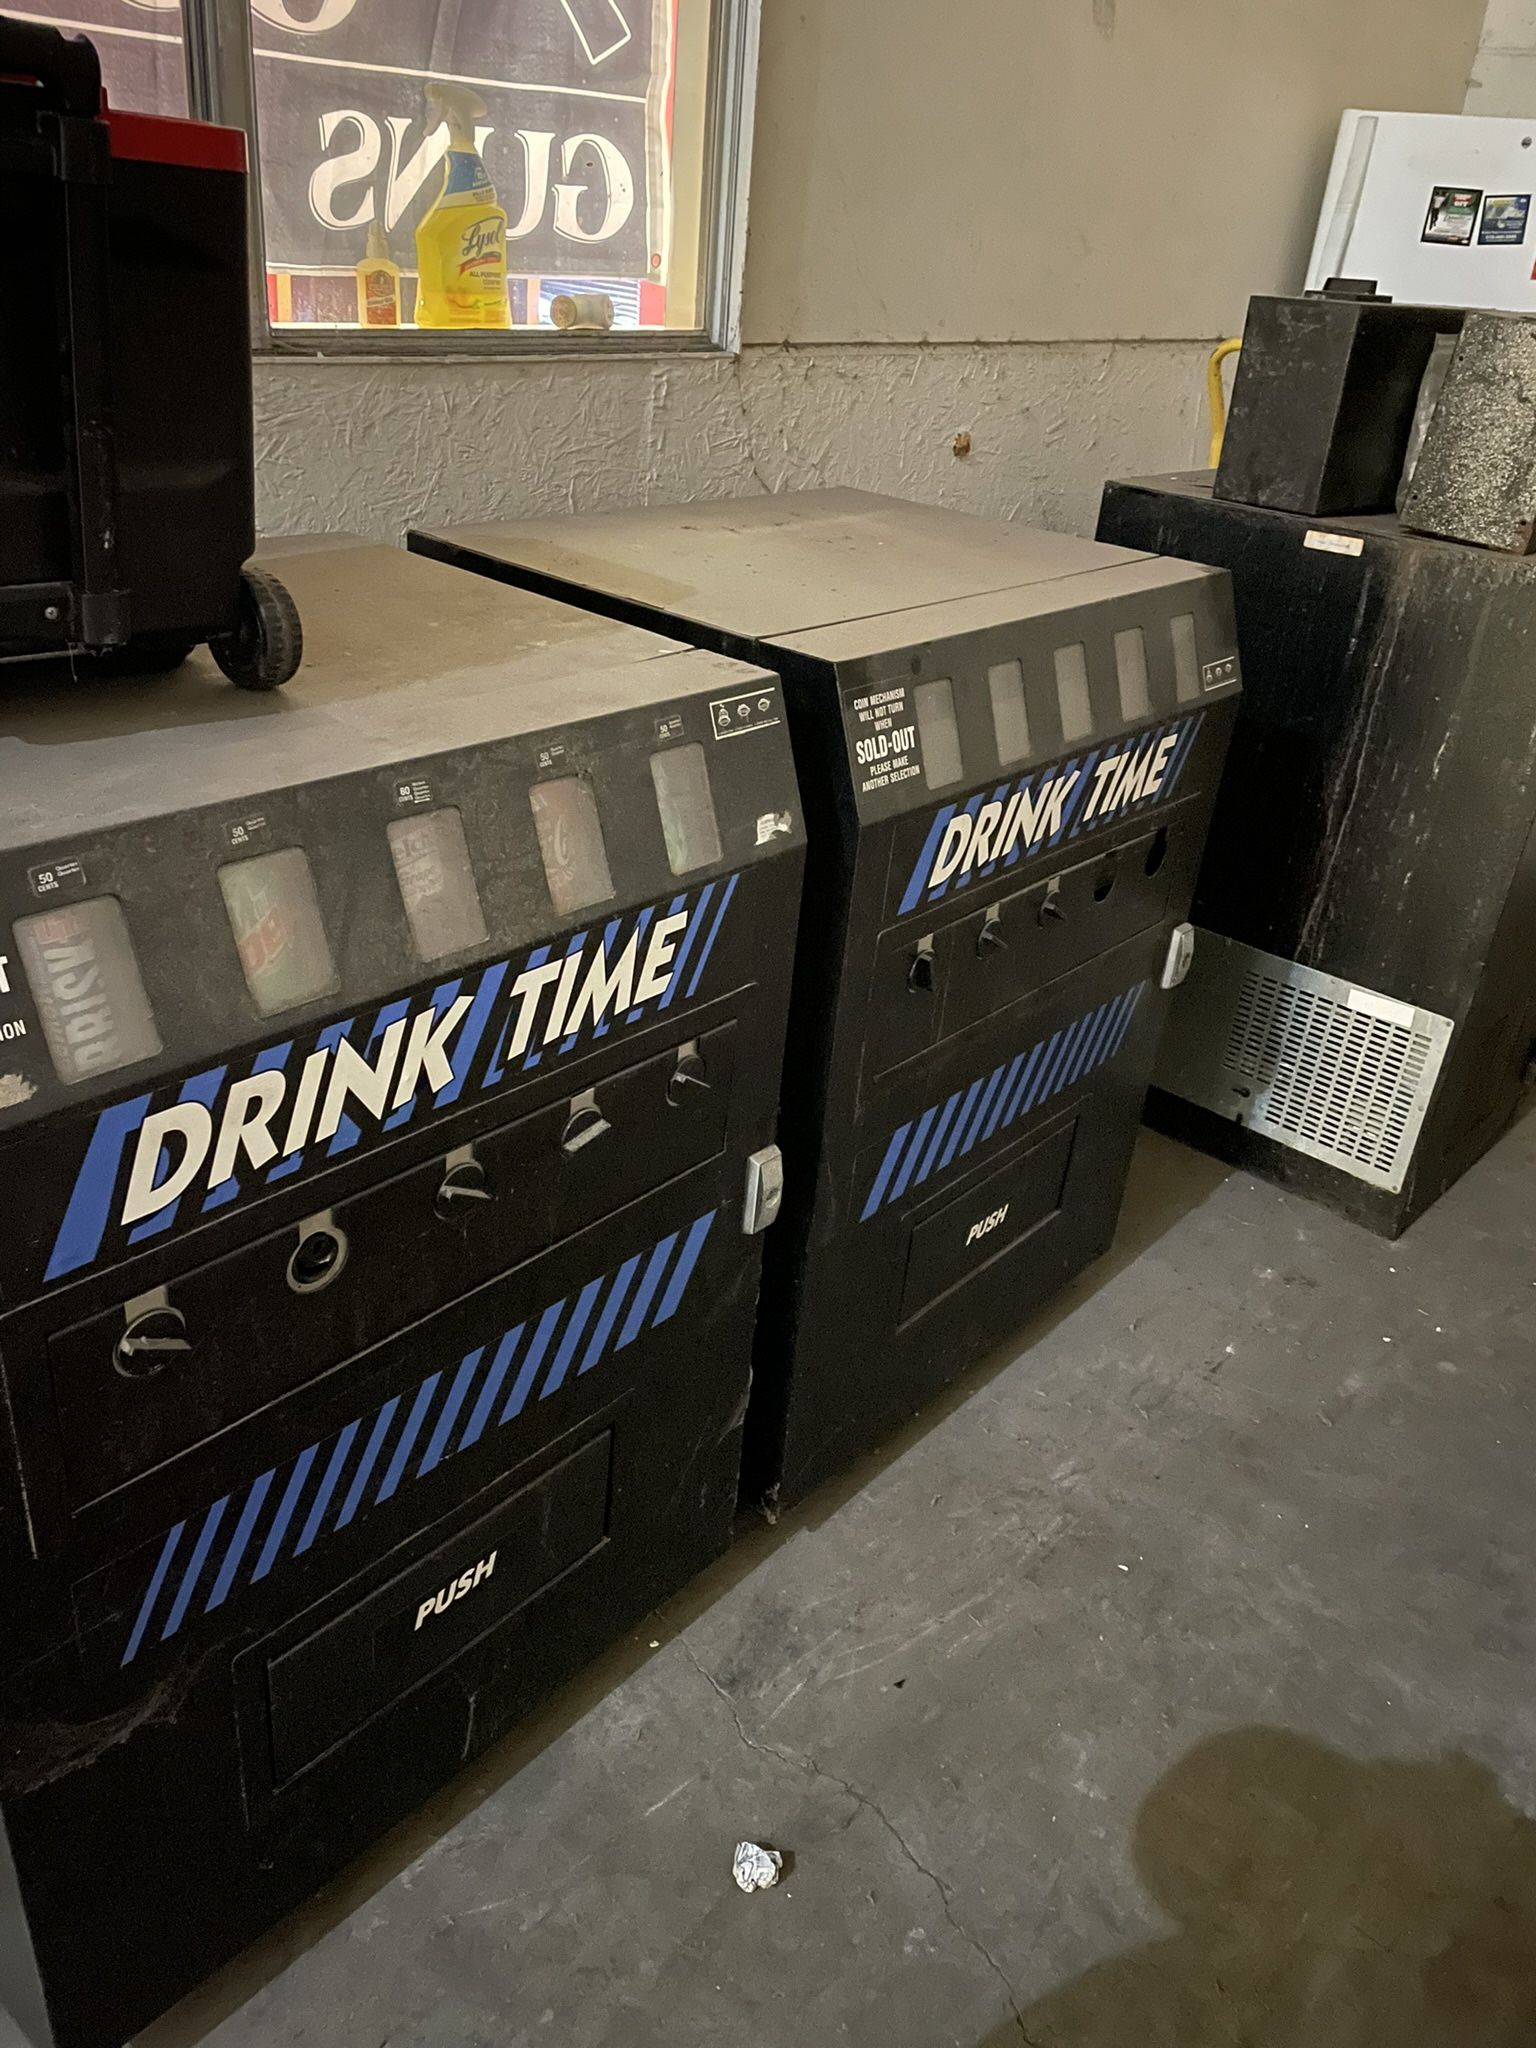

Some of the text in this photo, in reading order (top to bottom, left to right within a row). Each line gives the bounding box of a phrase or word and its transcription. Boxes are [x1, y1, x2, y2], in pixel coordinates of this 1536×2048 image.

[462, 221, 502, 257] Lysol
[854, 687, 905, 710] COIN MECHANISM
[859, 701, 904, 722] WILL NOT TURN
[874, 717, 893, 731] WHEN
[856, 726, 915, 764] SOLD-OUT
[540, 752, 550, 761] 50
[870, 755, 909, 776] PLEASE MAKE
[862, 764, 920, 792] ANOTHER SELECTION
[928, 733, 1178, 889] DRINK TIME
[231, 834, 249, 845] CENTS
[232, 825, 244, 837] 50
[37, 880, 59, 893] CENTS
[38, 872, 54, 884] 50
[121, 995, 475, 1226] DRINK
[507, 910, 689, 1061] TIME
[966, 1204, 1009, 1246] PUSH
[414, 1550, 497, 1631] PUSH
